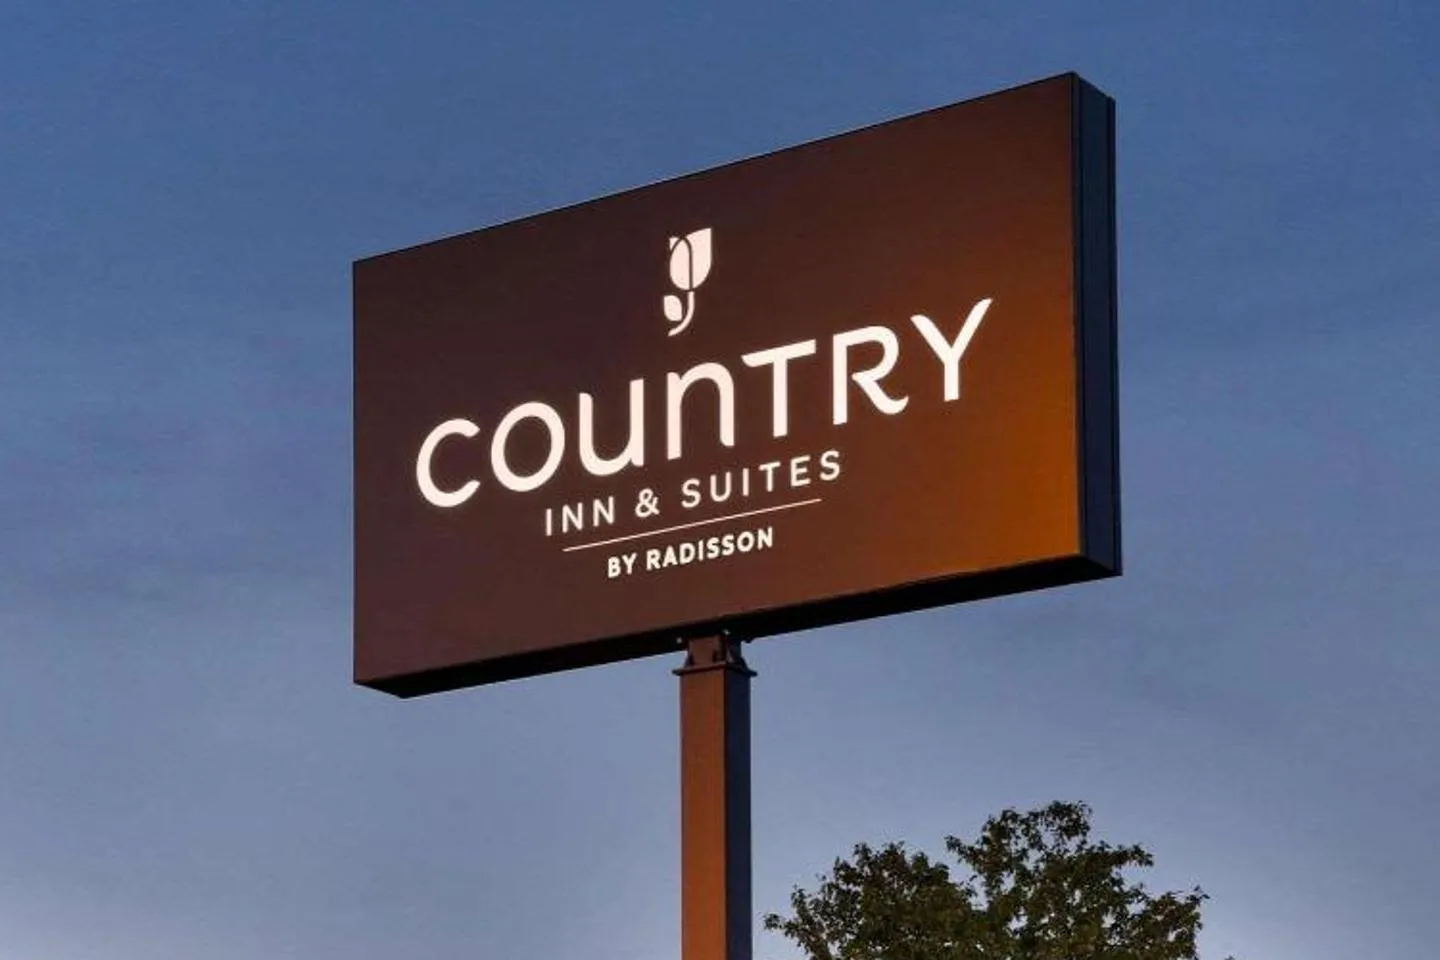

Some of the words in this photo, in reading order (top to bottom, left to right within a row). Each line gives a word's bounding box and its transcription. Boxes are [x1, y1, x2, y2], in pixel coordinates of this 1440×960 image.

[545, 496, 615, 536] INN
[634, 488, 660, 518] &
[681, 450, 841, 508] SUITES
[607, 552, 637, 578] BY
[646, 526, 774, 571] RADISSON
